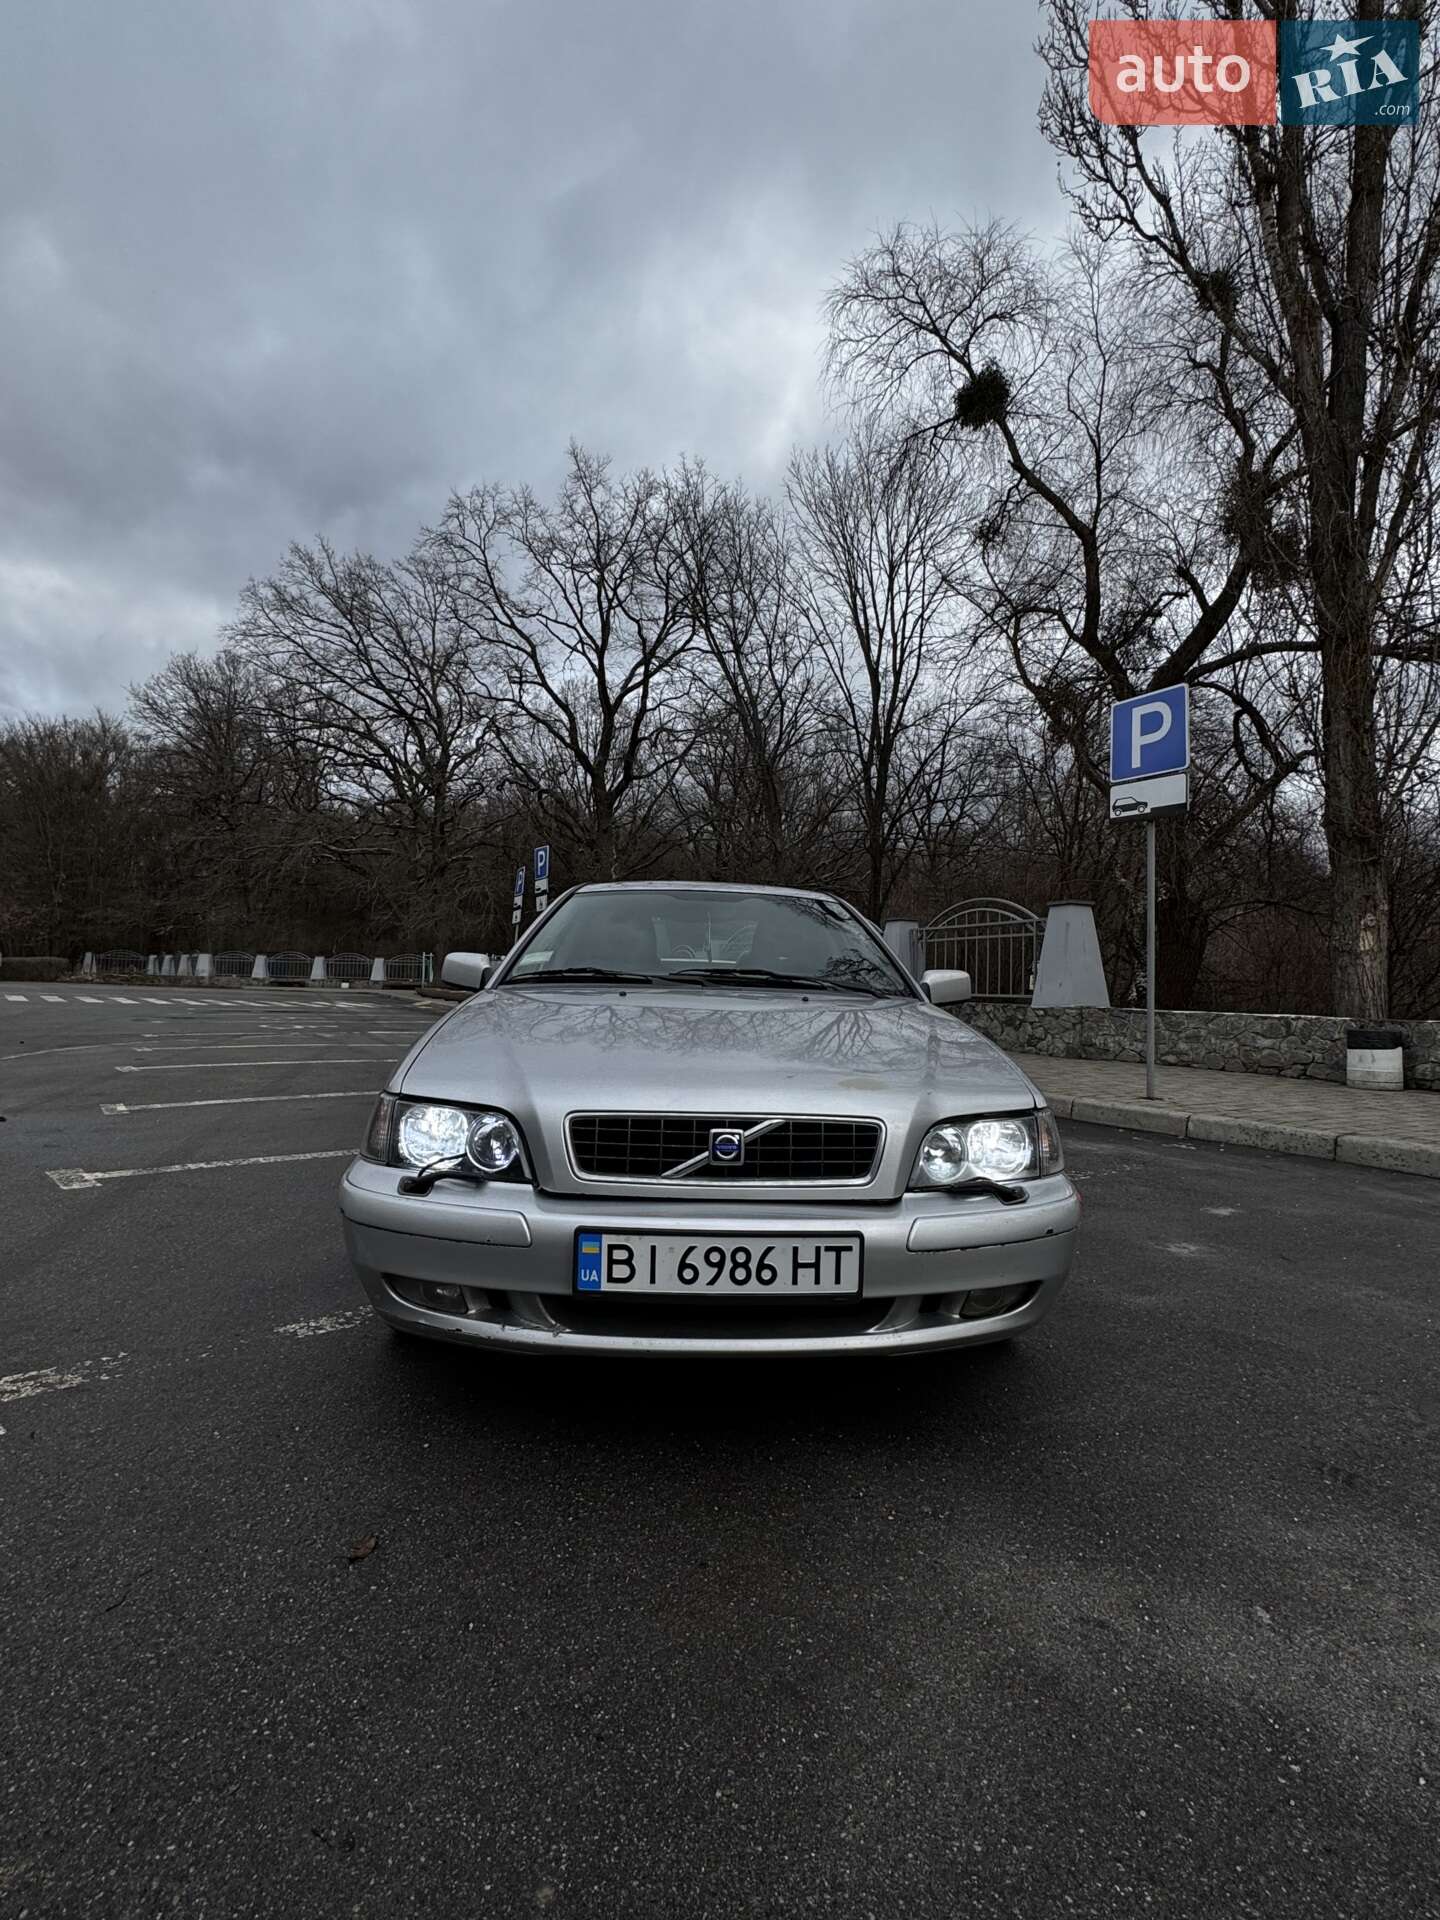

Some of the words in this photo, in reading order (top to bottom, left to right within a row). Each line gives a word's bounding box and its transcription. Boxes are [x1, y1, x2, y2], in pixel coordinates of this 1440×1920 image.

[1131, 701, 1172, 769] P
[537, 850, 546, 876] P
[581, 1269, 599, 1282] UA
[606, 1243, 657, 1285] BI
[676, 1245, 778, 1286] 6986
[791, 1245, 854, 1286] HT
